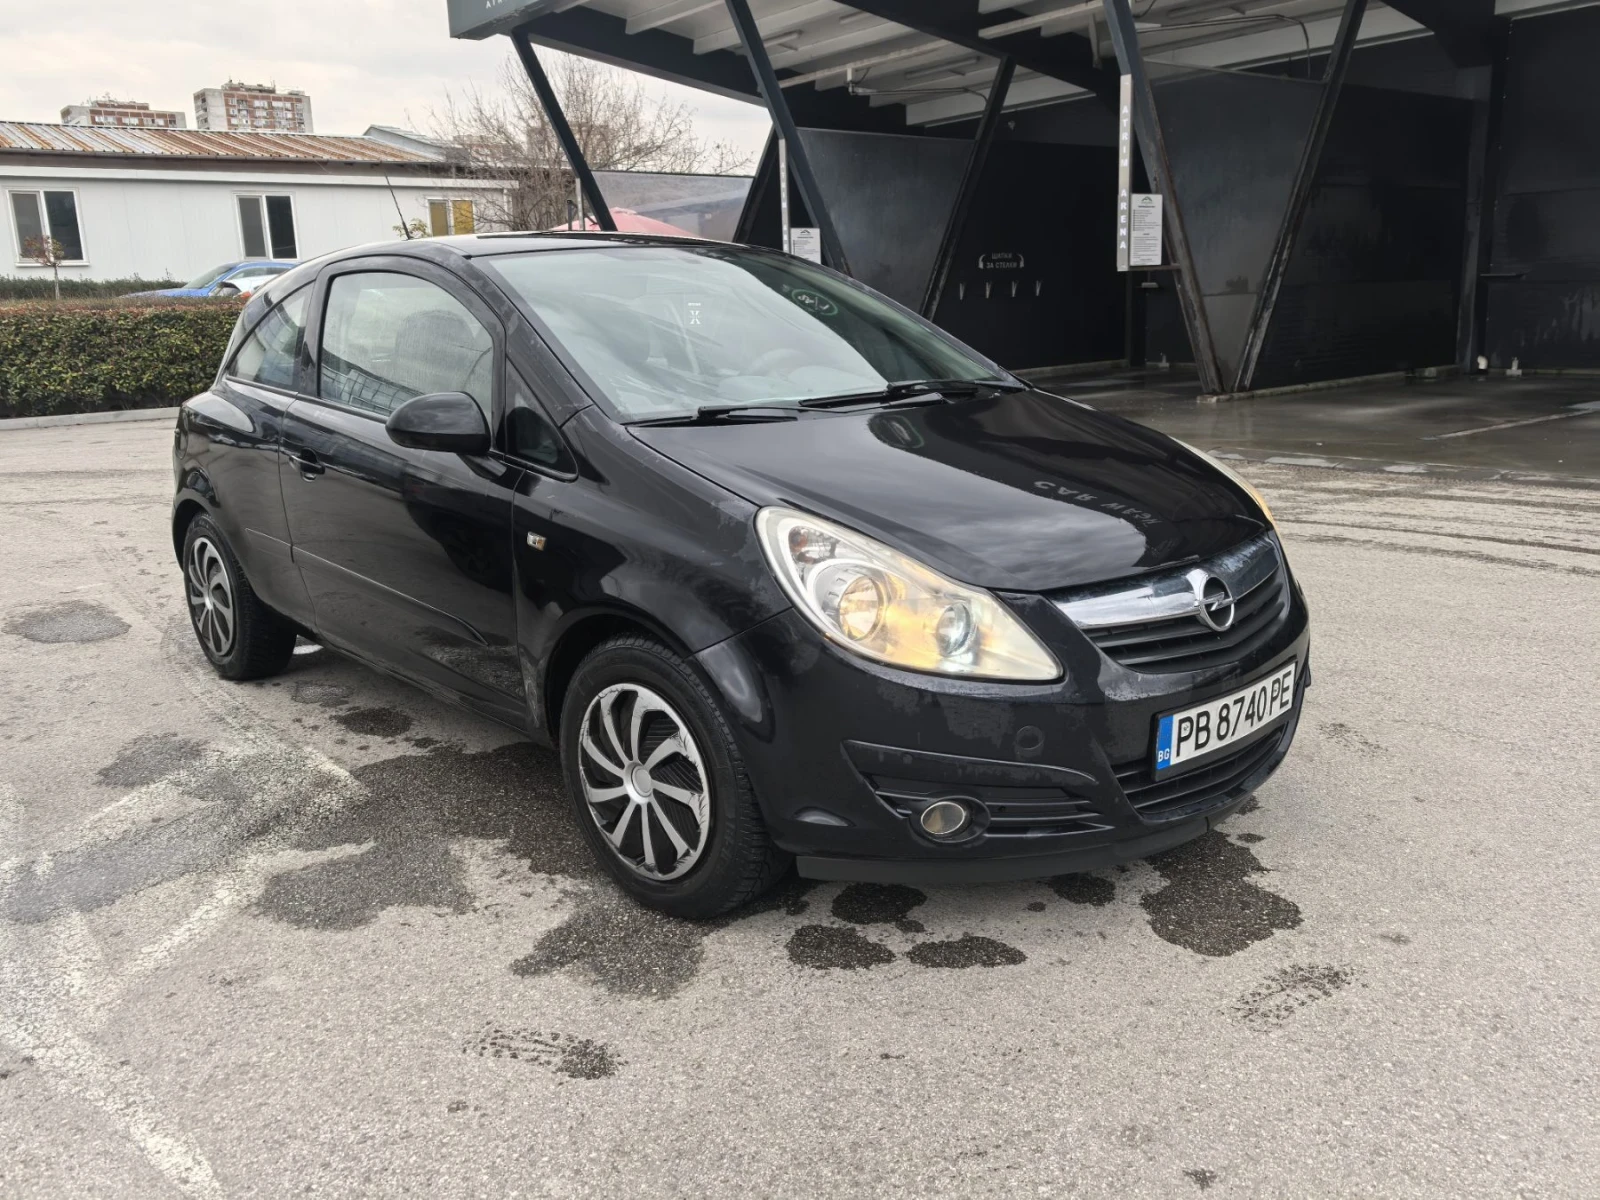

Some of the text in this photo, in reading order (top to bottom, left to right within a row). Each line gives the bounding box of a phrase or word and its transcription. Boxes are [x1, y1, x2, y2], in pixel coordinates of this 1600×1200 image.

[1119, 105, 1129, 249] ATRIM ARENA
[1157, 748, 1170, 763] BG
[1176, 669, 1292, 758] PB 8740 PE
